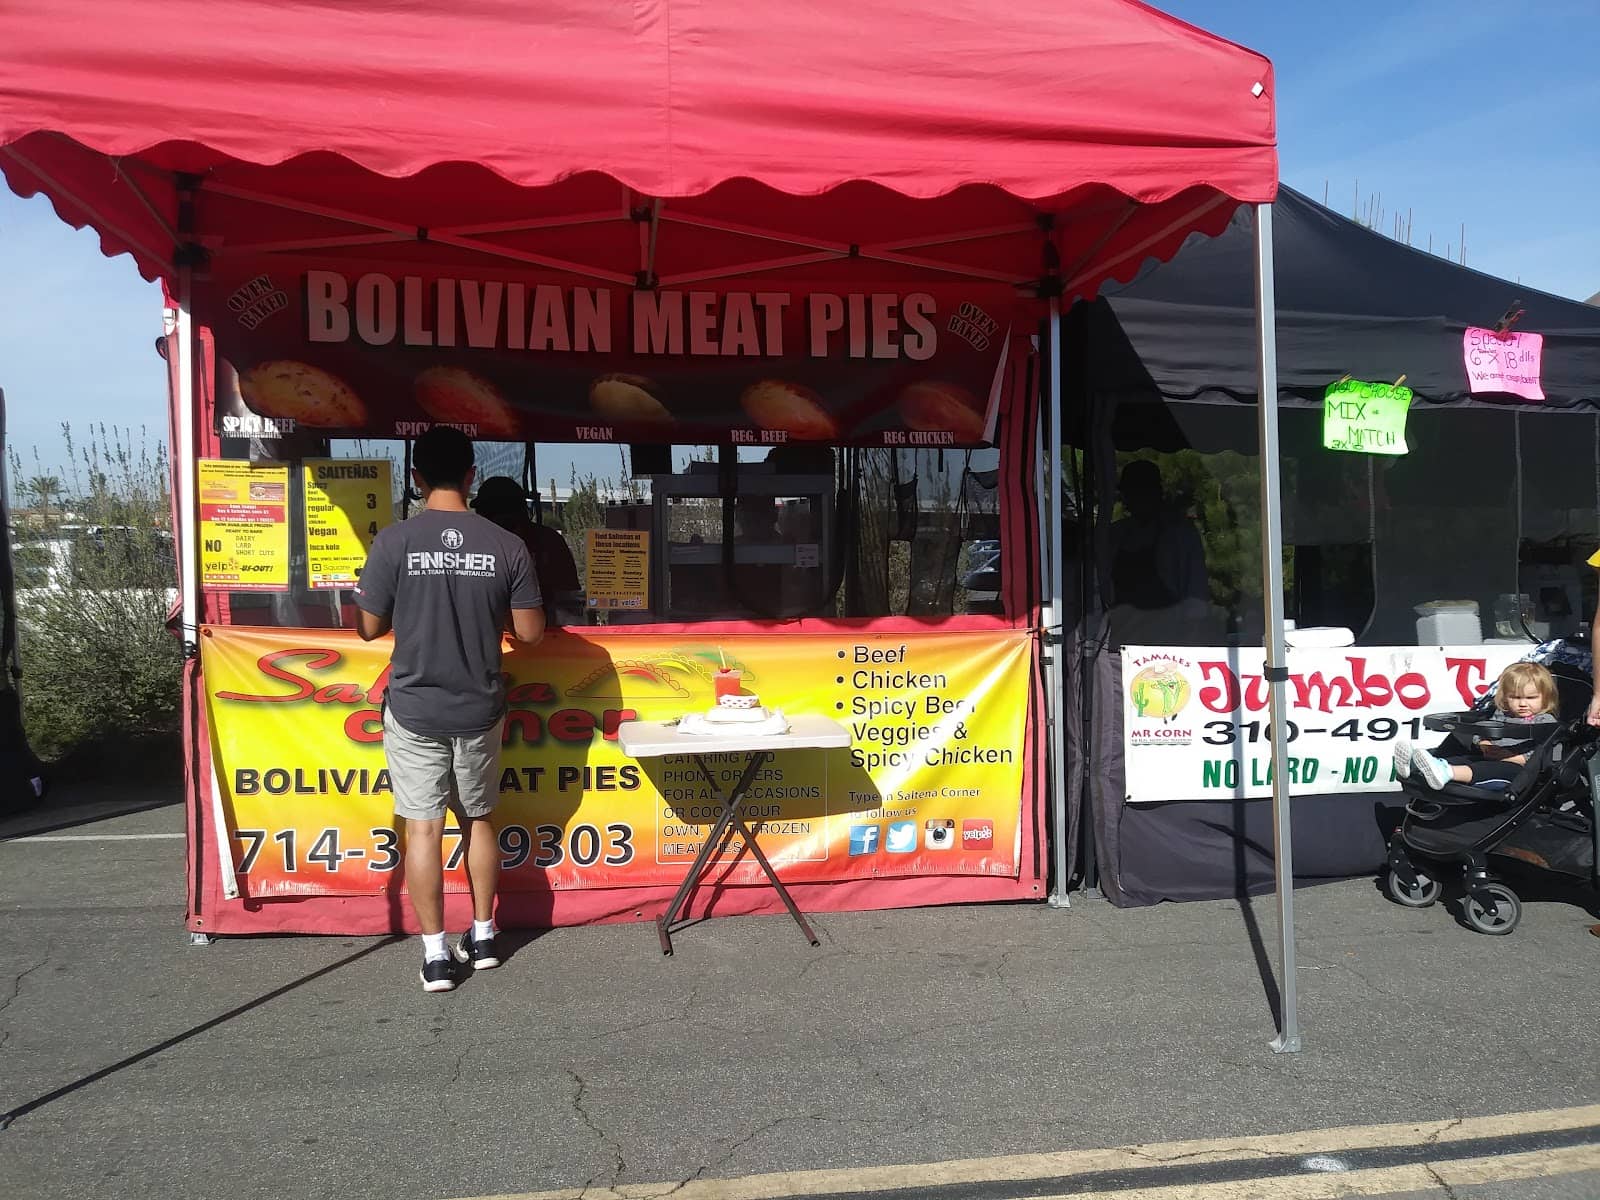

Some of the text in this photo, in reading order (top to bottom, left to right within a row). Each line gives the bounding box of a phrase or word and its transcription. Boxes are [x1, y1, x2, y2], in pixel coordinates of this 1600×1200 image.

[228, 274, 273, 311] OVEN
[239, 291, 288, 329] BAKED
[306, 270, 938, 360] BOLIVIAN MEAT PIES
[959, 302, 999, 336] OVEN
[949, 315, 990, 351] BAKED
[1328, 401, 1367, 420] MIX
[223, 416, 296, 433] SPICY BEEF
[395, 420, 430, 435] SPICY
[575, 427, 613, 441] VEGAN
[731, 430, 789, 443] REG. BEEF
[884, 431, 955, 445] REG CHICKEN
[318, 464, 378, 480] SALTEÑAS
[366, 493, 377, 509] 3
[308, 527, 338, 537] Vegan
[368, 521, 378, 536] 4
[205, 539, 222, 552] NO
[205, 561, 228, 573] yelp
[407, 551, 496, 571] FINISHER
[854, 645, 906, 663] Beef
[1132, 653, 1192, 668] TAMALES
[852, 671, 947, 689] Chicken
[1197, 656, 1431, 714] Jumbo
[852, 696, 917, 720] Spicy
[344, 708, 637, 743] cner
[953, 721, 968, 740] &
[1131, 729, 1192, 738] MR CORN
[664, 751, 775, 765] CATRING AD
[850, 746, 1012, 772] Spicy Chicken
[235, 765, 641, 795] BOLIVIA AT PIES
[721, 769, 783, 782] ORERS
[1203, 760, 1240, 789] NO
[664, 789, 694, 801] FOR
[848, 790, 879, 804] Type
[941, 787, 981, 798] Corner
[663, 805, 780, 819] OR COO YOUR
[866, 806, 902, 819] follow
[905, 806, 917, 815] us
[751, 822, 810, 834] FROZEN
[963, 829, 983, 840] yelp
[663, 841, 742, 856] MEAT IES
